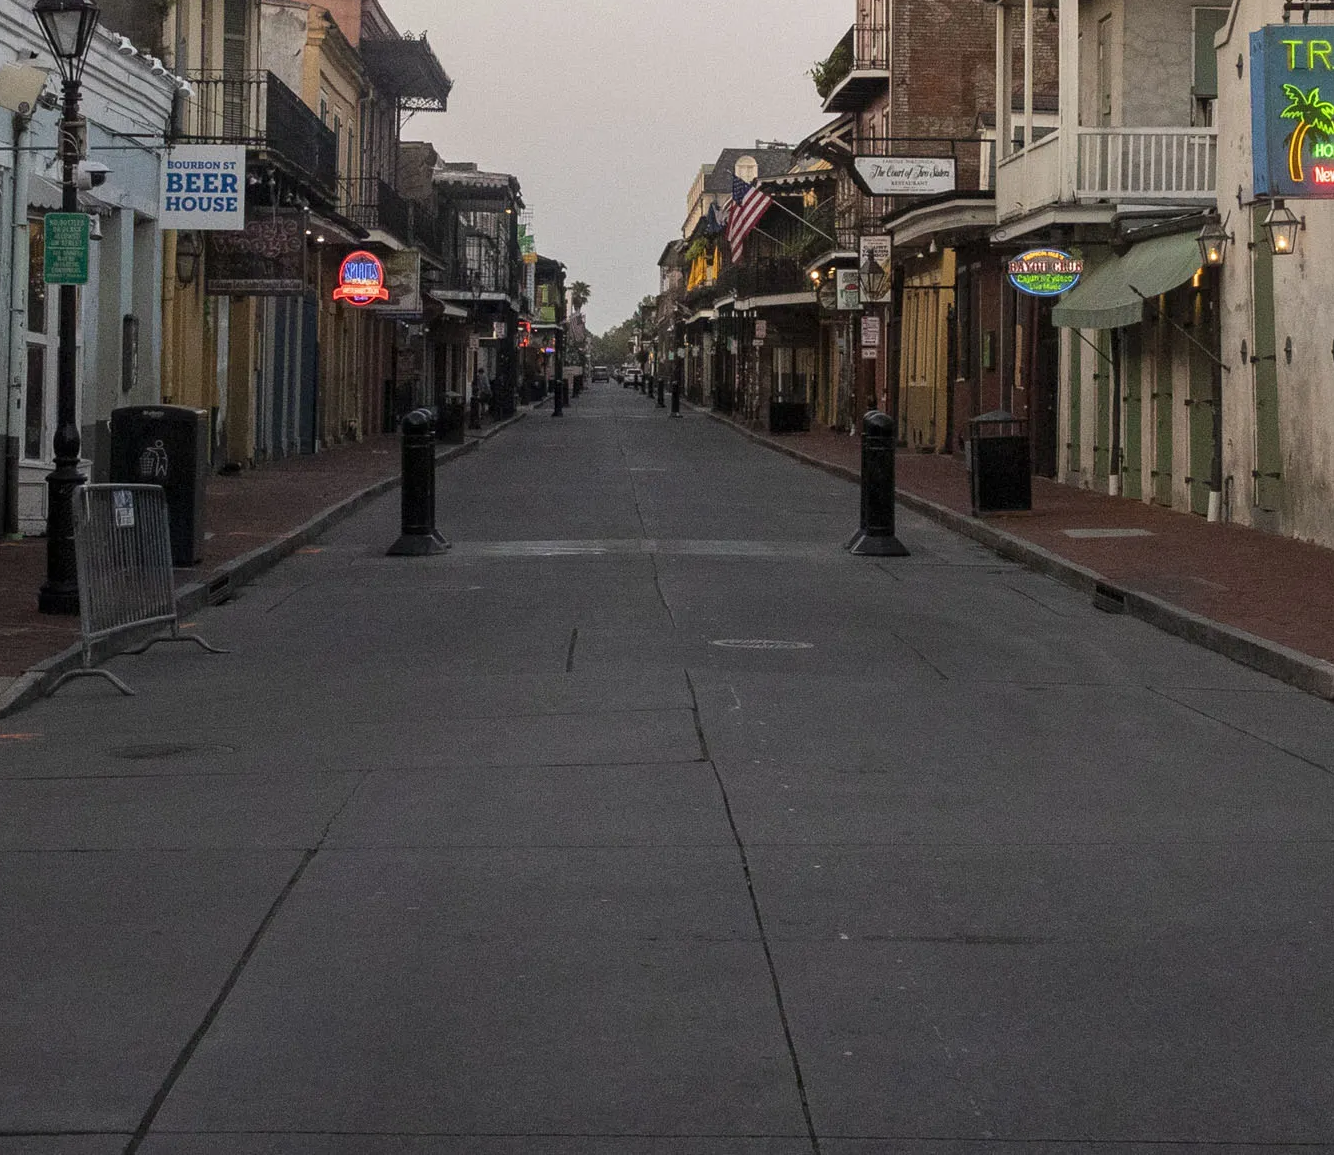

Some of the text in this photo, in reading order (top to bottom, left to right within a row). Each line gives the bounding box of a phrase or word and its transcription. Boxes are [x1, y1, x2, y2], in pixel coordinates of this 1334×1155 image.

[167, 160, 237, 170] BOURBON ST
[870, 163, 886, 179] The
[166, 173, 238, 193] BEER
[165, 197, 238, 212] HOUSE
[344, 262, 379, 279] SPIRITS
[1008, 259, 1084, 274] BAYOU CLUB
